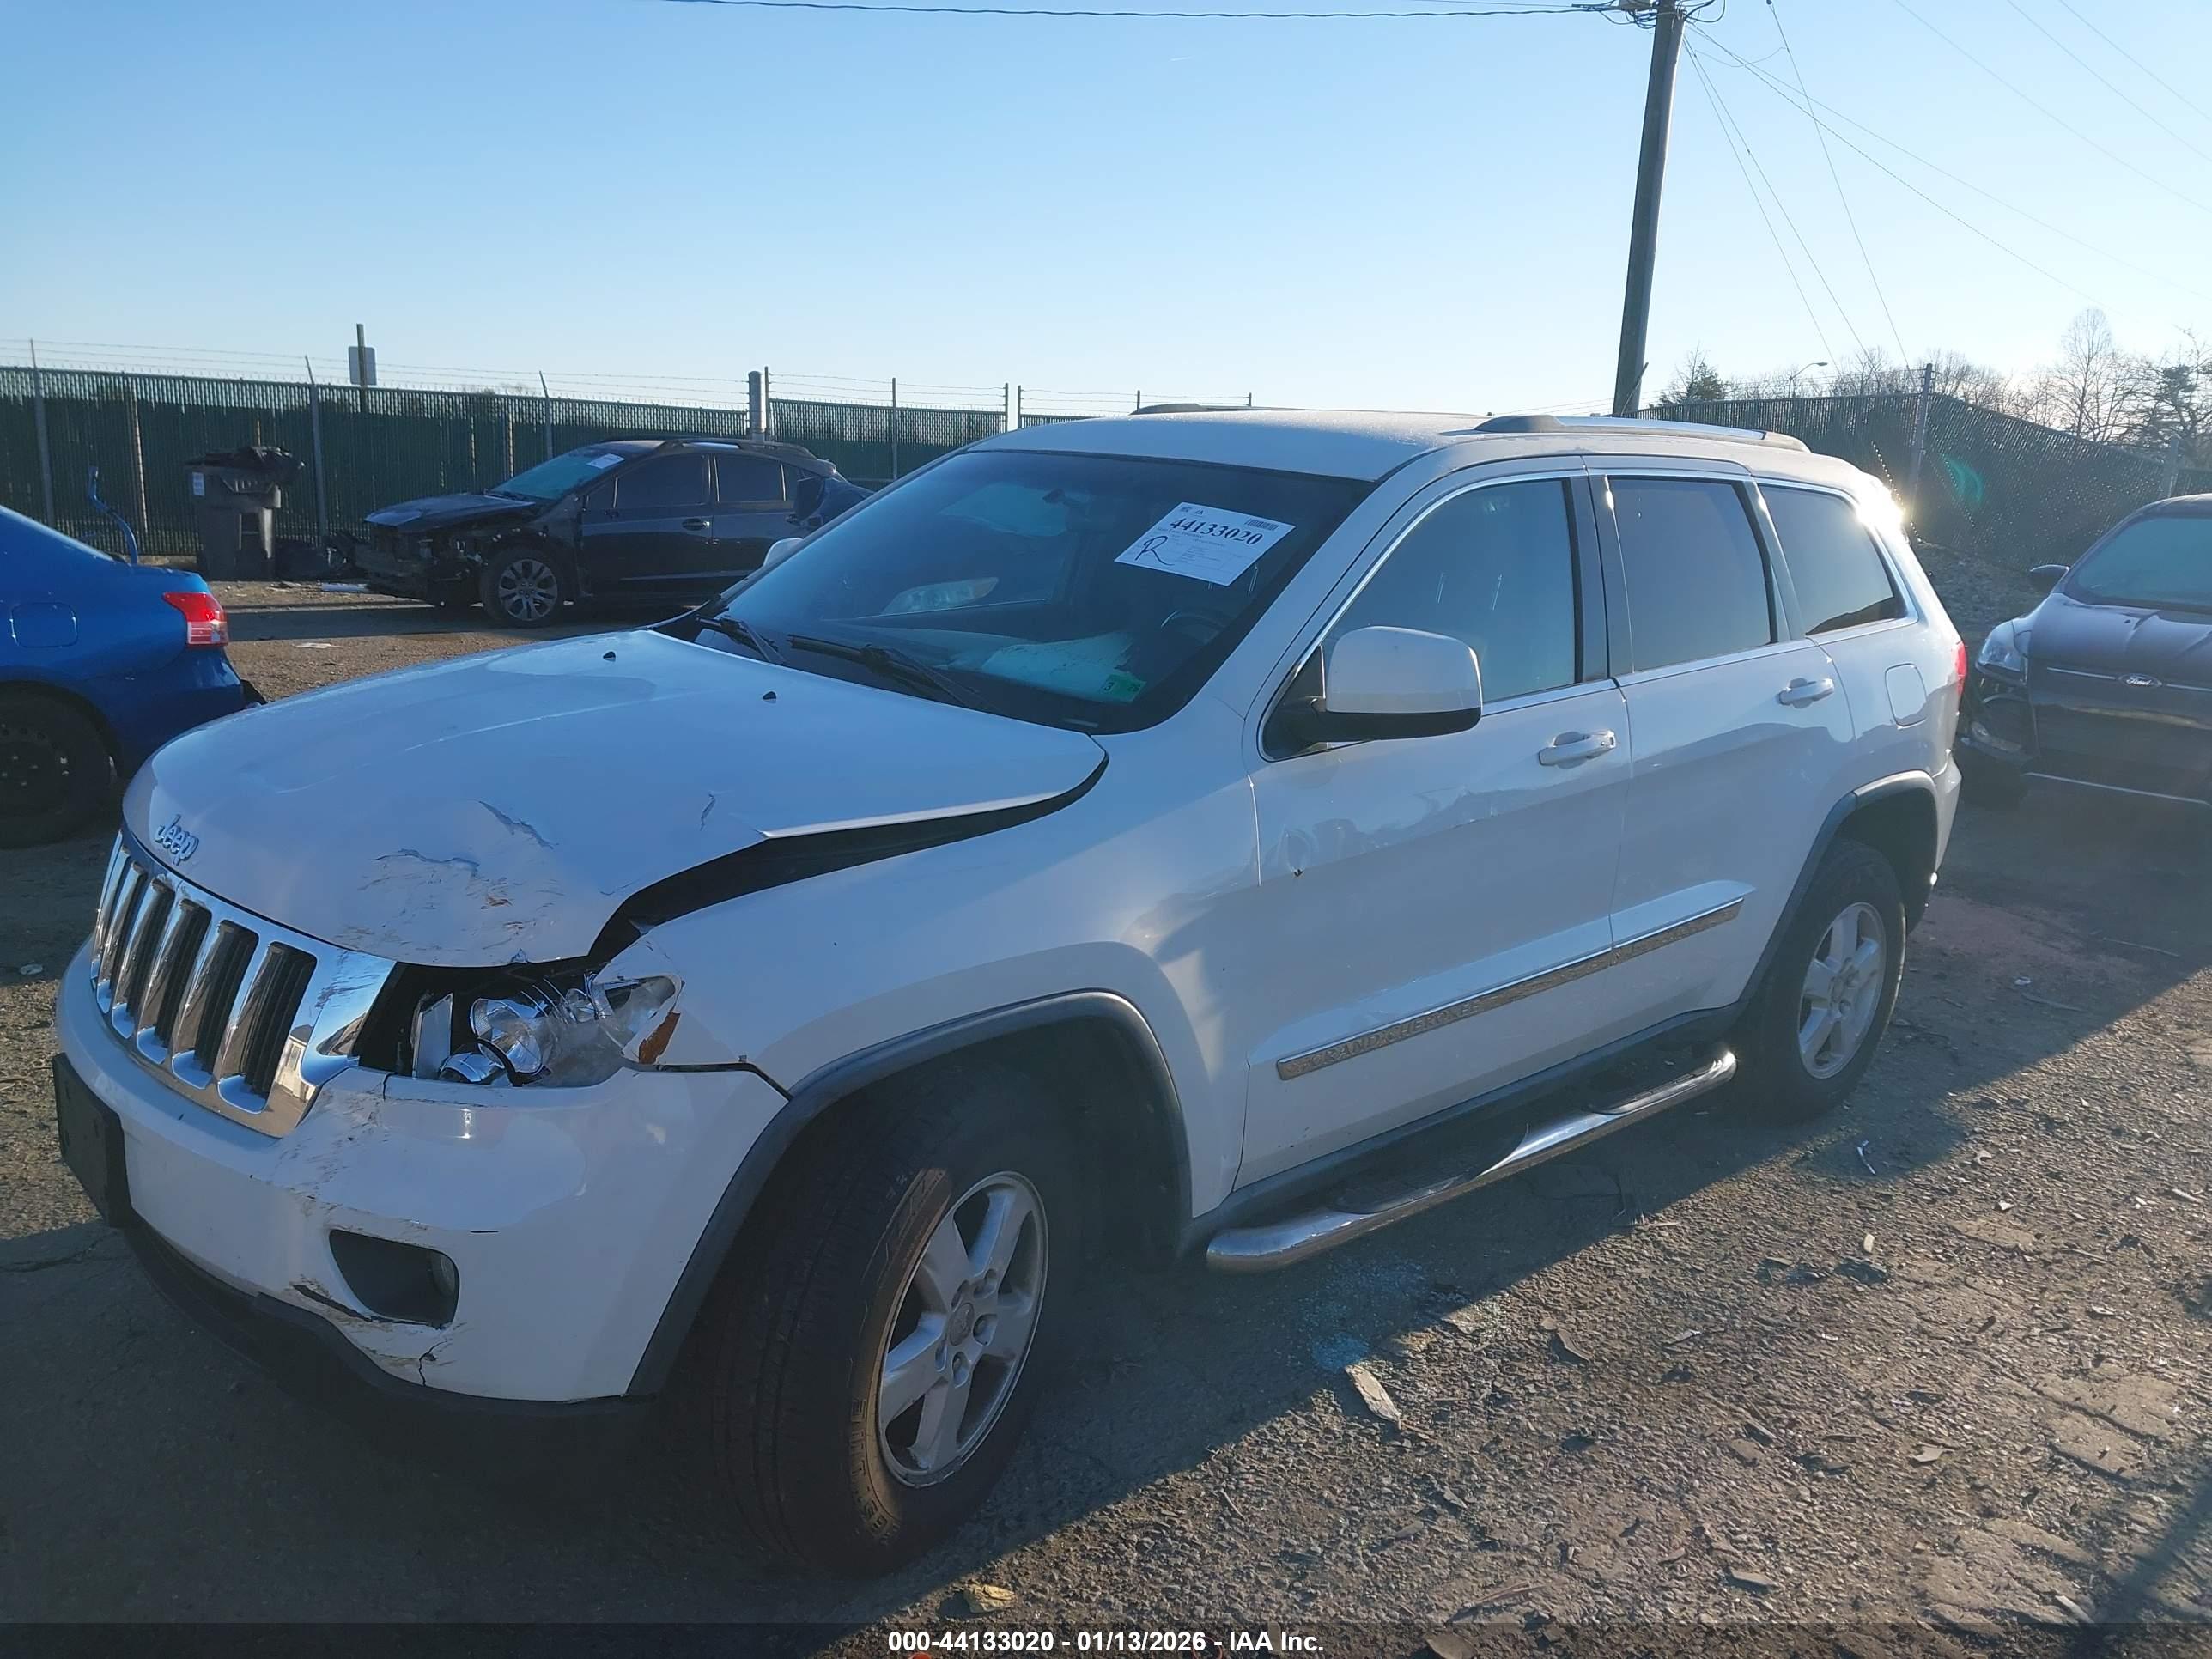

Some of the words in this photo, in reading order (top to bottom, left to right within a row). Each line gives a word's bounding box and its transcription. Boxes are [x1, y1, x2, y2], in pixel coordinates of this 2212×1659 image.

[1170, 518, 1263, 545] 44133020
[1134, 535, 1175, 567] R
[155, 814, 200, 866] Jeep
[1312, 1034, 1381, 1066] GRAND
